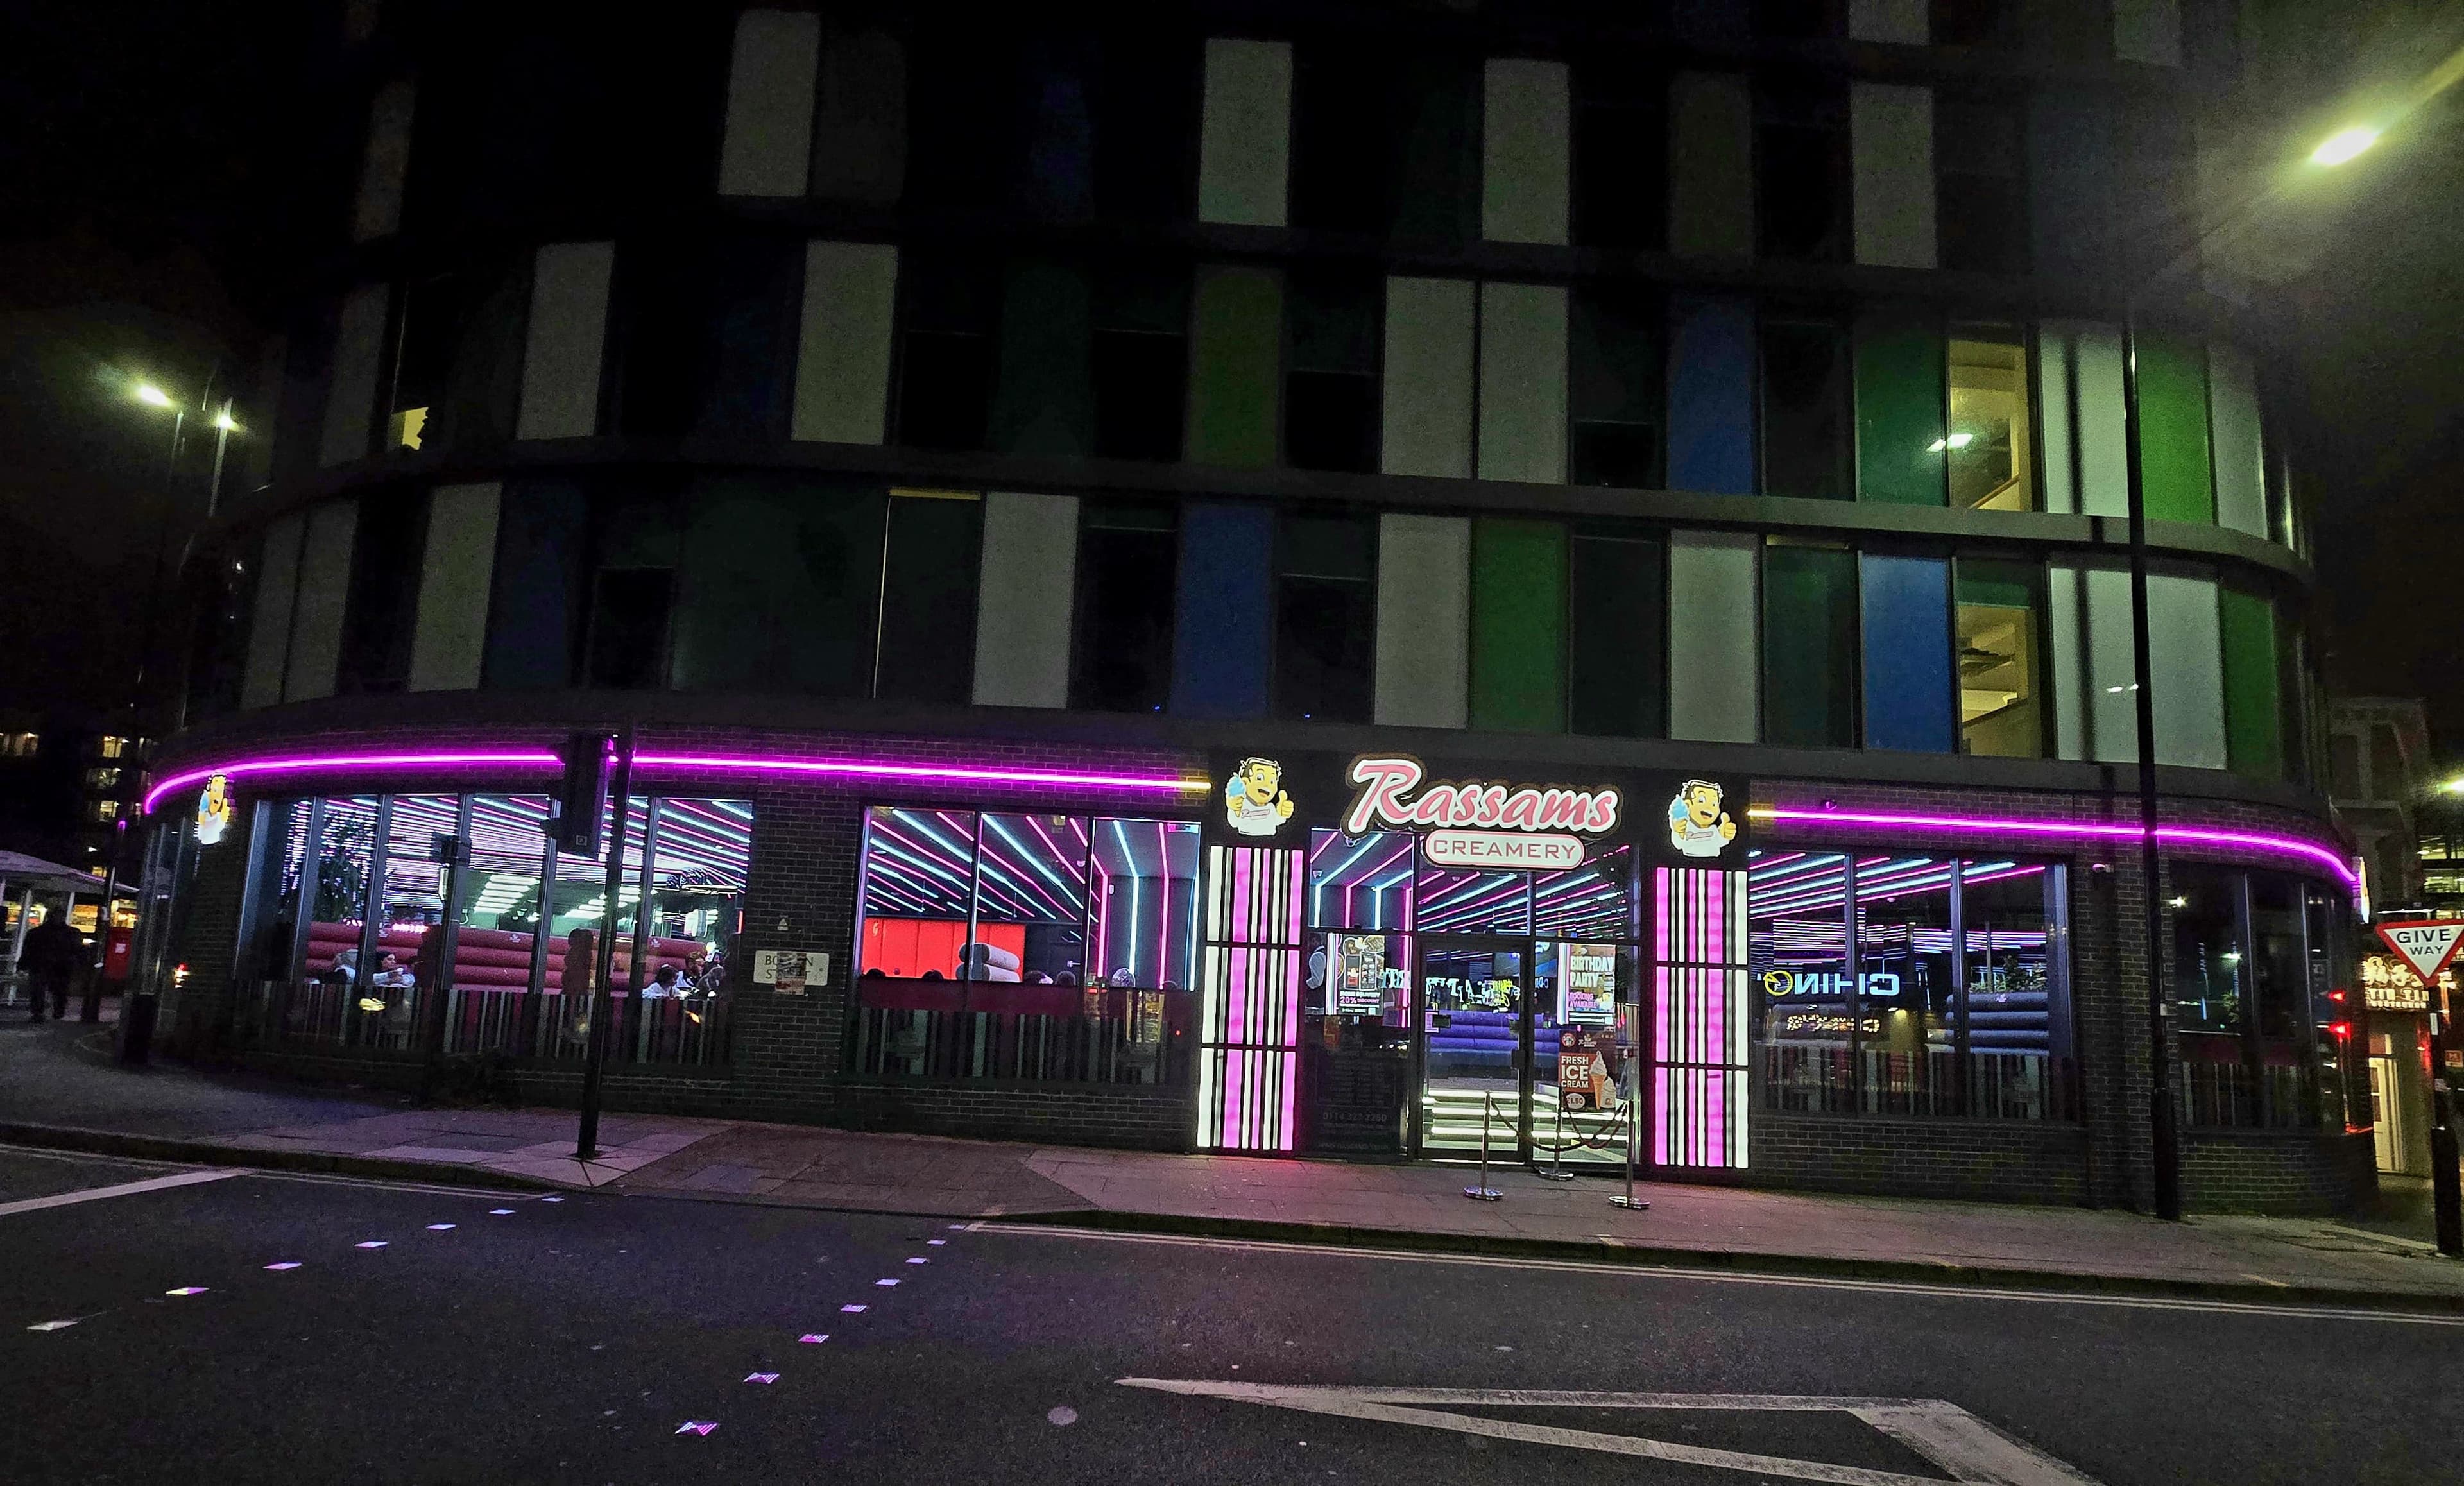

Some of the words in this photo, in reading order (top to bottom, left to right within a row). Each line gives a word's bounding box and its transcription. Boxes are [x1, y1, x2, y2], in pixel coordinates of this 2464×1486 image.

[1349, 760, 1617, 833] Rassams
[1433, 839, 1577, 860] CREAMERY
[2396, 928, 2452, 944] GIVE
[2409, 945, 2444, 955] WAY
[1570, 956, 1614, 972] BIRTHDAY
[1570, 972, 1599, 987] PARTY
[1561, 1055, 1589, 1065] FRESH
[1561, 1065, 1589, 1080] ICE
